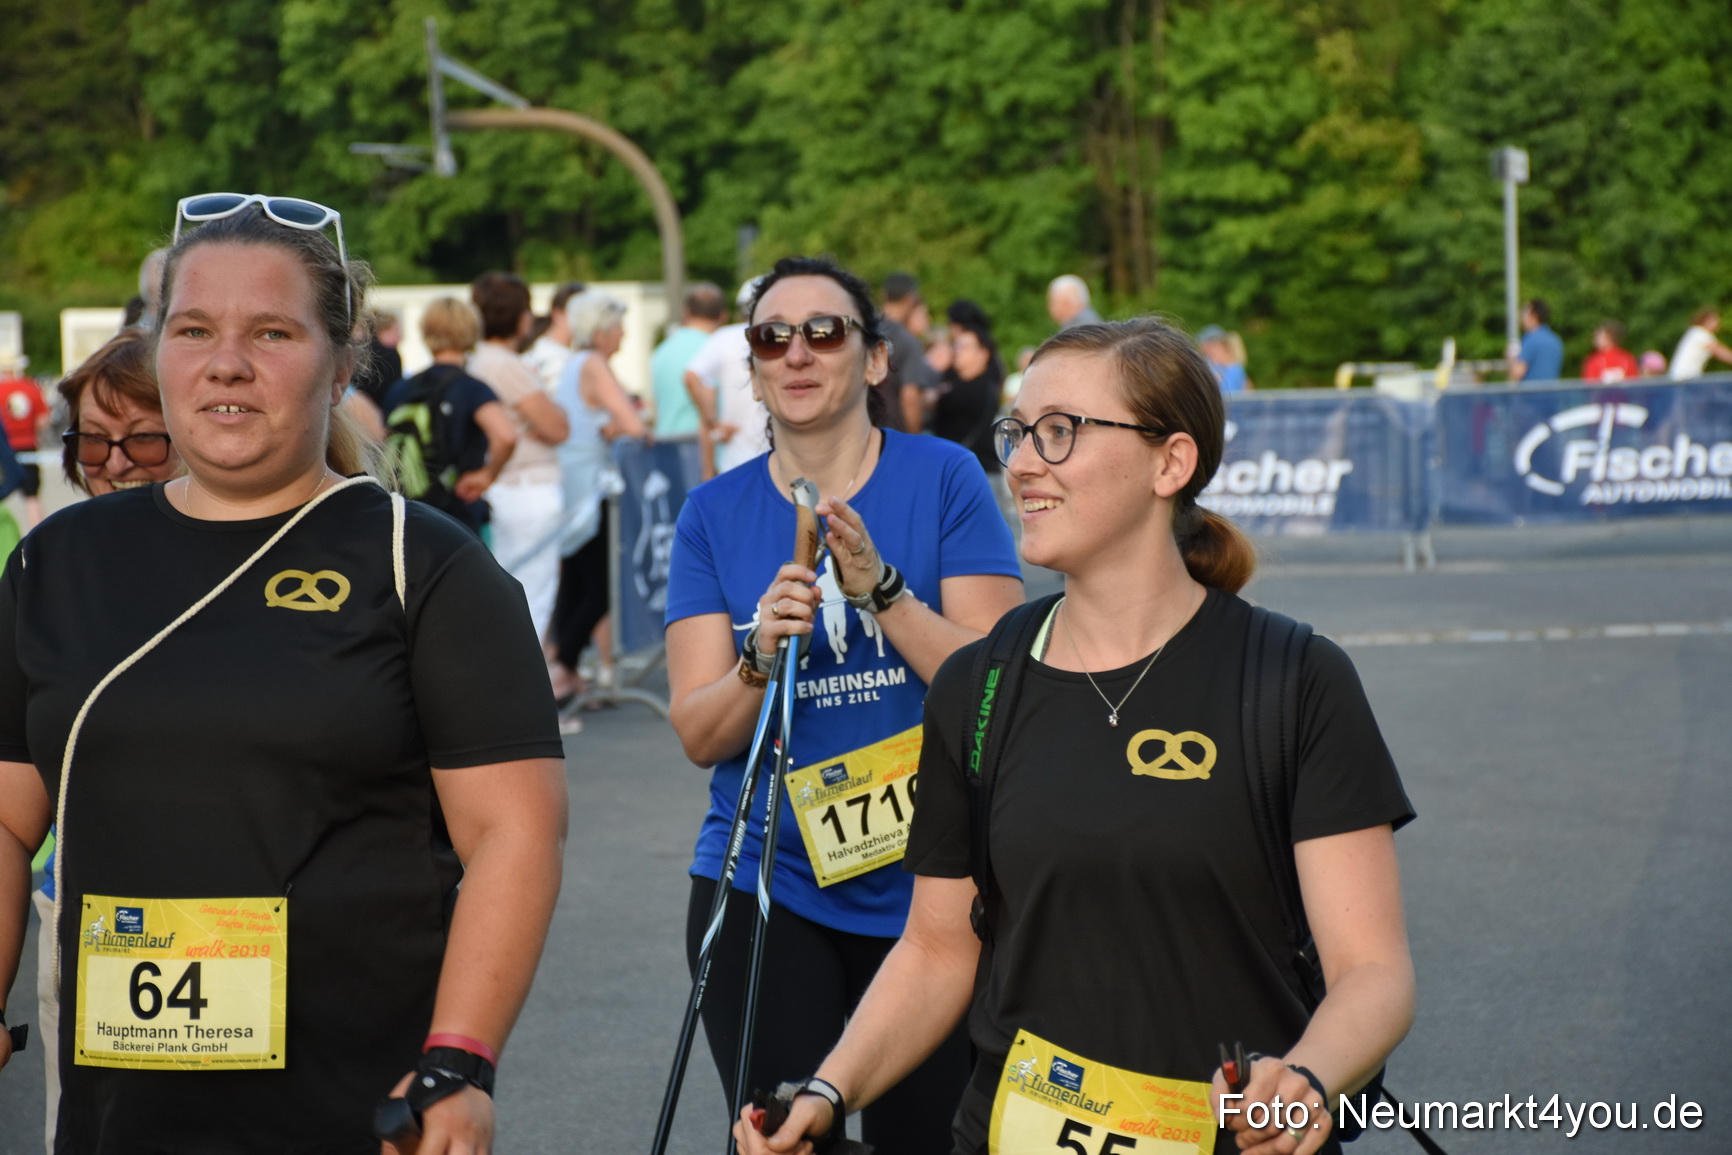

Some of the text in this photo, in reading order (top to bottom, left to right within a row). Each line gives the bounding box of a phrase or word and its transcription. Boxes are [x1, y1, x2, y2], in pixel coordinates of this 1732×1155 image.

[793, 666, 906, 699] EMEINSAM
[816, 690, 880, 709] INS ZIEL
[970, 667, 1000, 774] DAKINE
[815, 769, 873, 801] firmenlauf
[827, 829, 903, 862] Halvadzhieva
[861, 843, 896, 860] Medaktiv
[103, 931, 176, 948] firmenlauf
[185, 939, 271, 958] walk 2019
[129, 961, 208, 1020] 64
[97, 1021, 254, 1040] Hauptmann Theresa
[113, 1040, 228, 1053] Bäckerei Plank GmbH
[1031, 1074, 1114, 1116] firmenlauf
[1119, 1118, 1202, 1144] walk 2019
